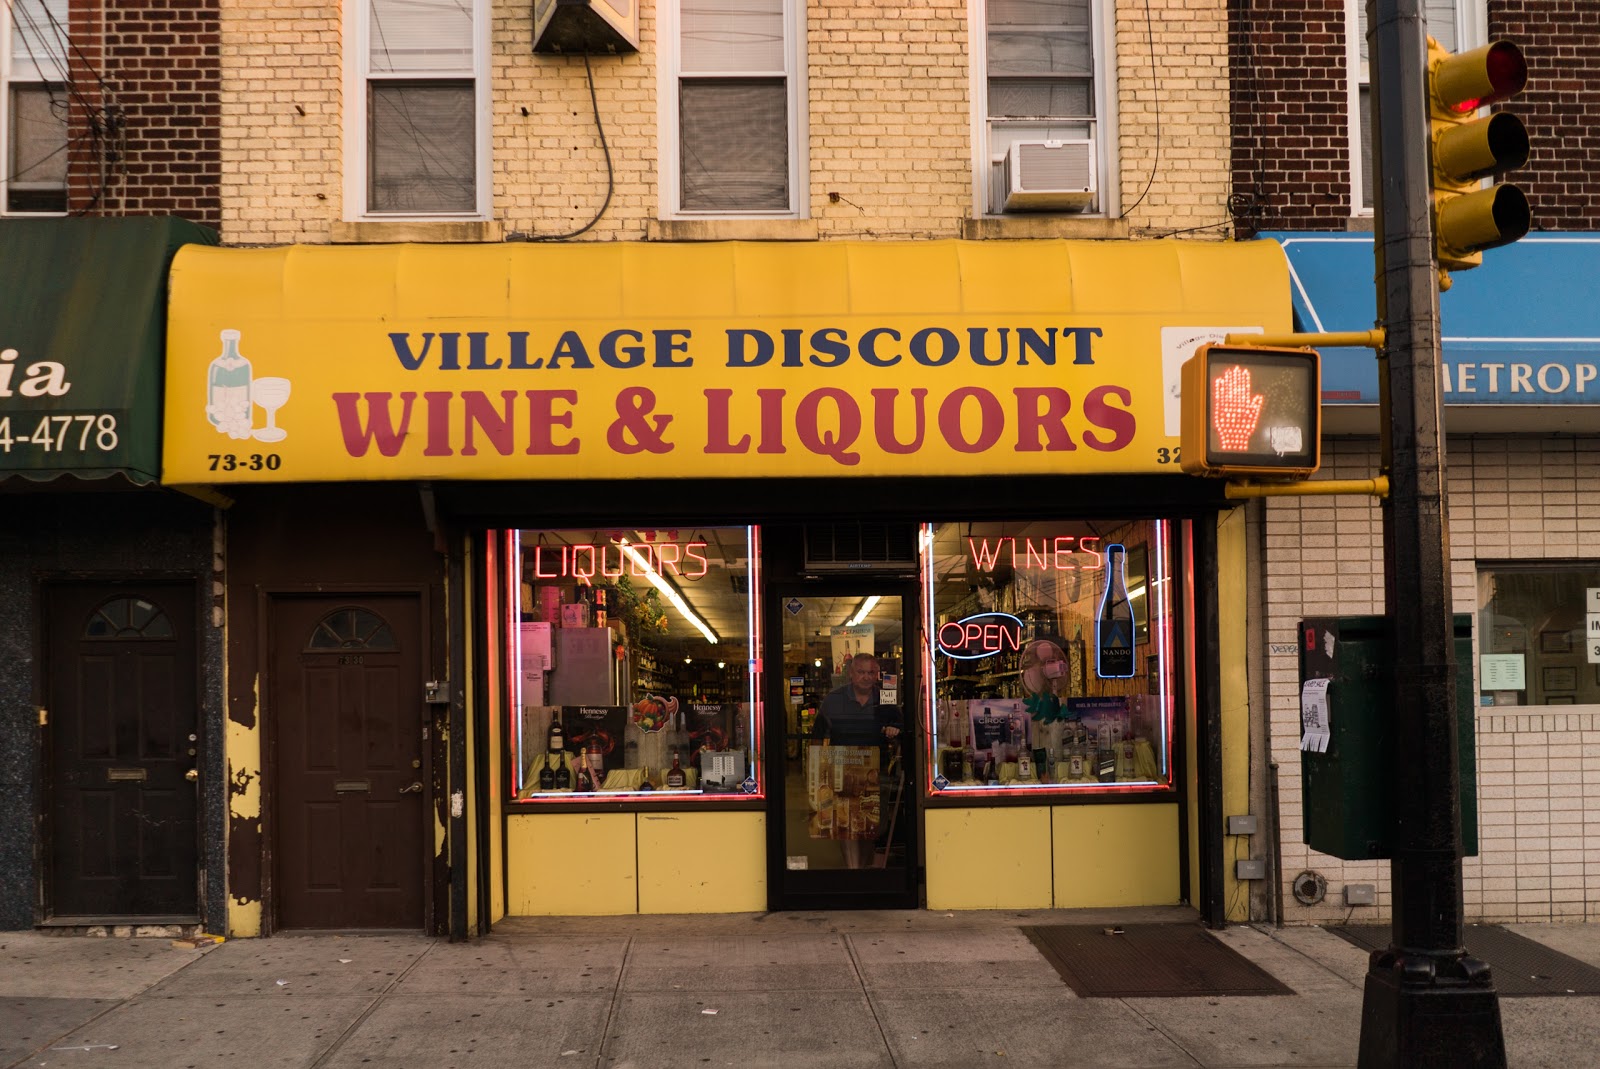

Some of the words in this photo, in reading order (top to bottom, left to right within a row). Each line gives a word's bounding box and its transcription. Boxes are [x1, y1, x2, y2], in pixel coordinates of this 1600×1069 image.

[388, 329, 694, 371] VILLAGE
[725, 327, 1103, 367] DISCOUNT
[1176, 335, 1206, 350] Village
[0, 348, 72, 397] ia
[1442, 362, 1598, 395] ETROP
[332, 390, 581, 458] WINE
[606, 386, 675, 455] &
[703, 385, 1137, 467] LIQUORS
[207, 453, 282, 472] 73-30
[534, 542, 709, 588] LIQUORS
[968, 536, 1102, 571] WINES
[938, 621, 1022, 651] OPEN
[1102, 649, 1132, 657] NANDO
[579, 707, 608, 716] Hennessy
[693, 703, 721, 712] Hennessy
